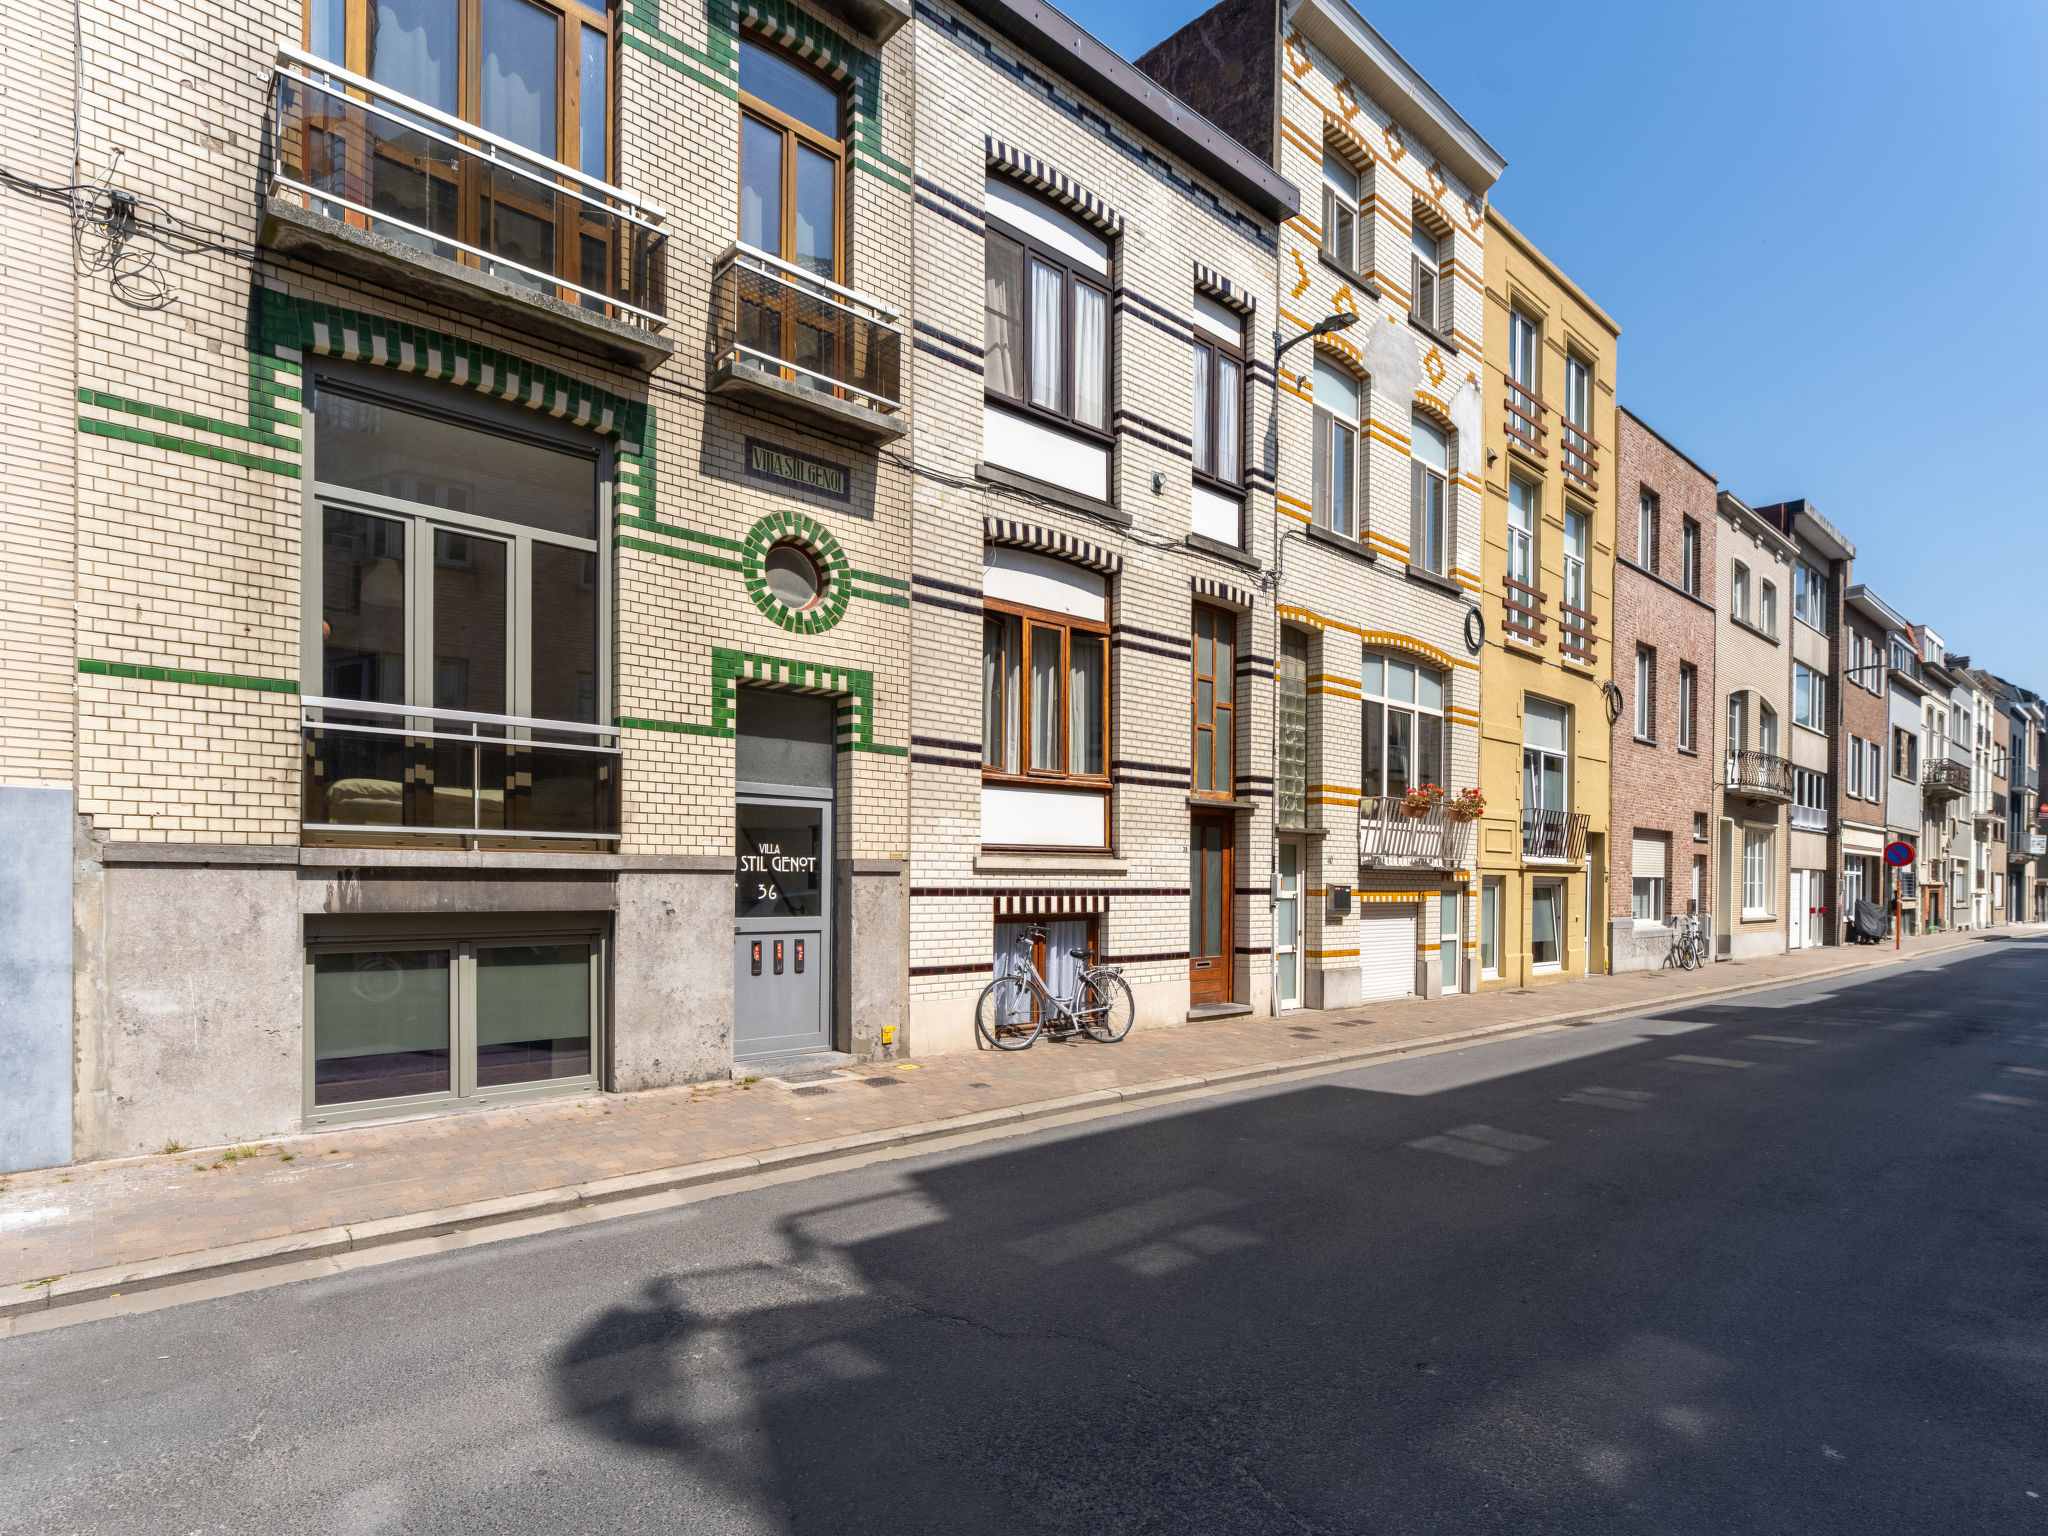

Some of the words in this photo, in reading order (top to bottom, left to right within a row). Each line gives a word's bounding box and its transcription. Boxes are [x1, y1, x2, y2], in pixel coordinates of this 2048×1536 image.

[759, 843, 780, 854] VILLA
[741, 855, 768, 872] STIL
[772, 856, 816, 872] GENOT
[758, 884, 777, 899] 36
